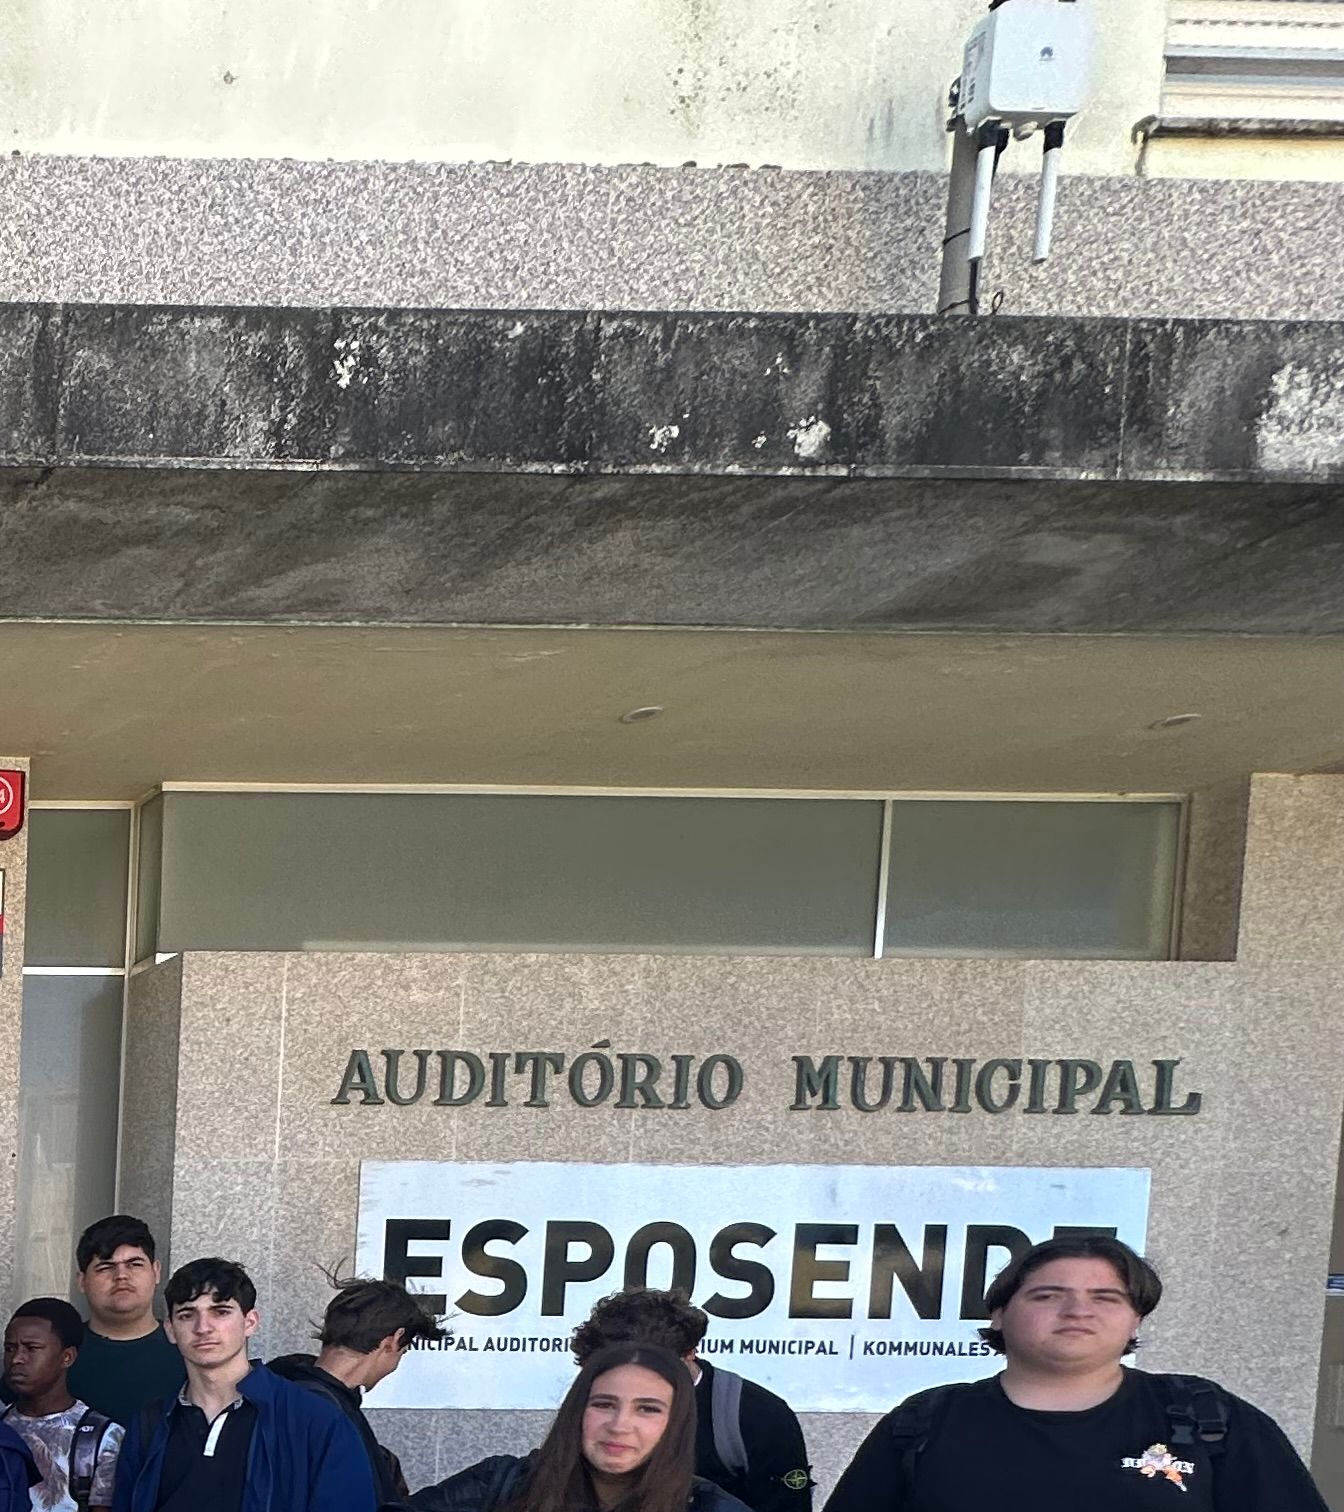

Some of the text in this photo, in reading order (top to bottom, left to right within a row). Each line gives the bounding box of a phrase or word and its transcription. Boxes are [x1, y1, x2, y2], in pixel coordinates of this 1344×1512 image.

[330, 1039, 1204, 1116] AUDITÓRIO MUNICIPAL
[382, 1218, 1118, 1320] ESPOSEND
[408, 1336, 570, 1352] NICIPAL AUDITORI
[739, 1338, 839, 1356] MUNICIPAL
[863, 1340, 991, 1357] KOMMUNALES
